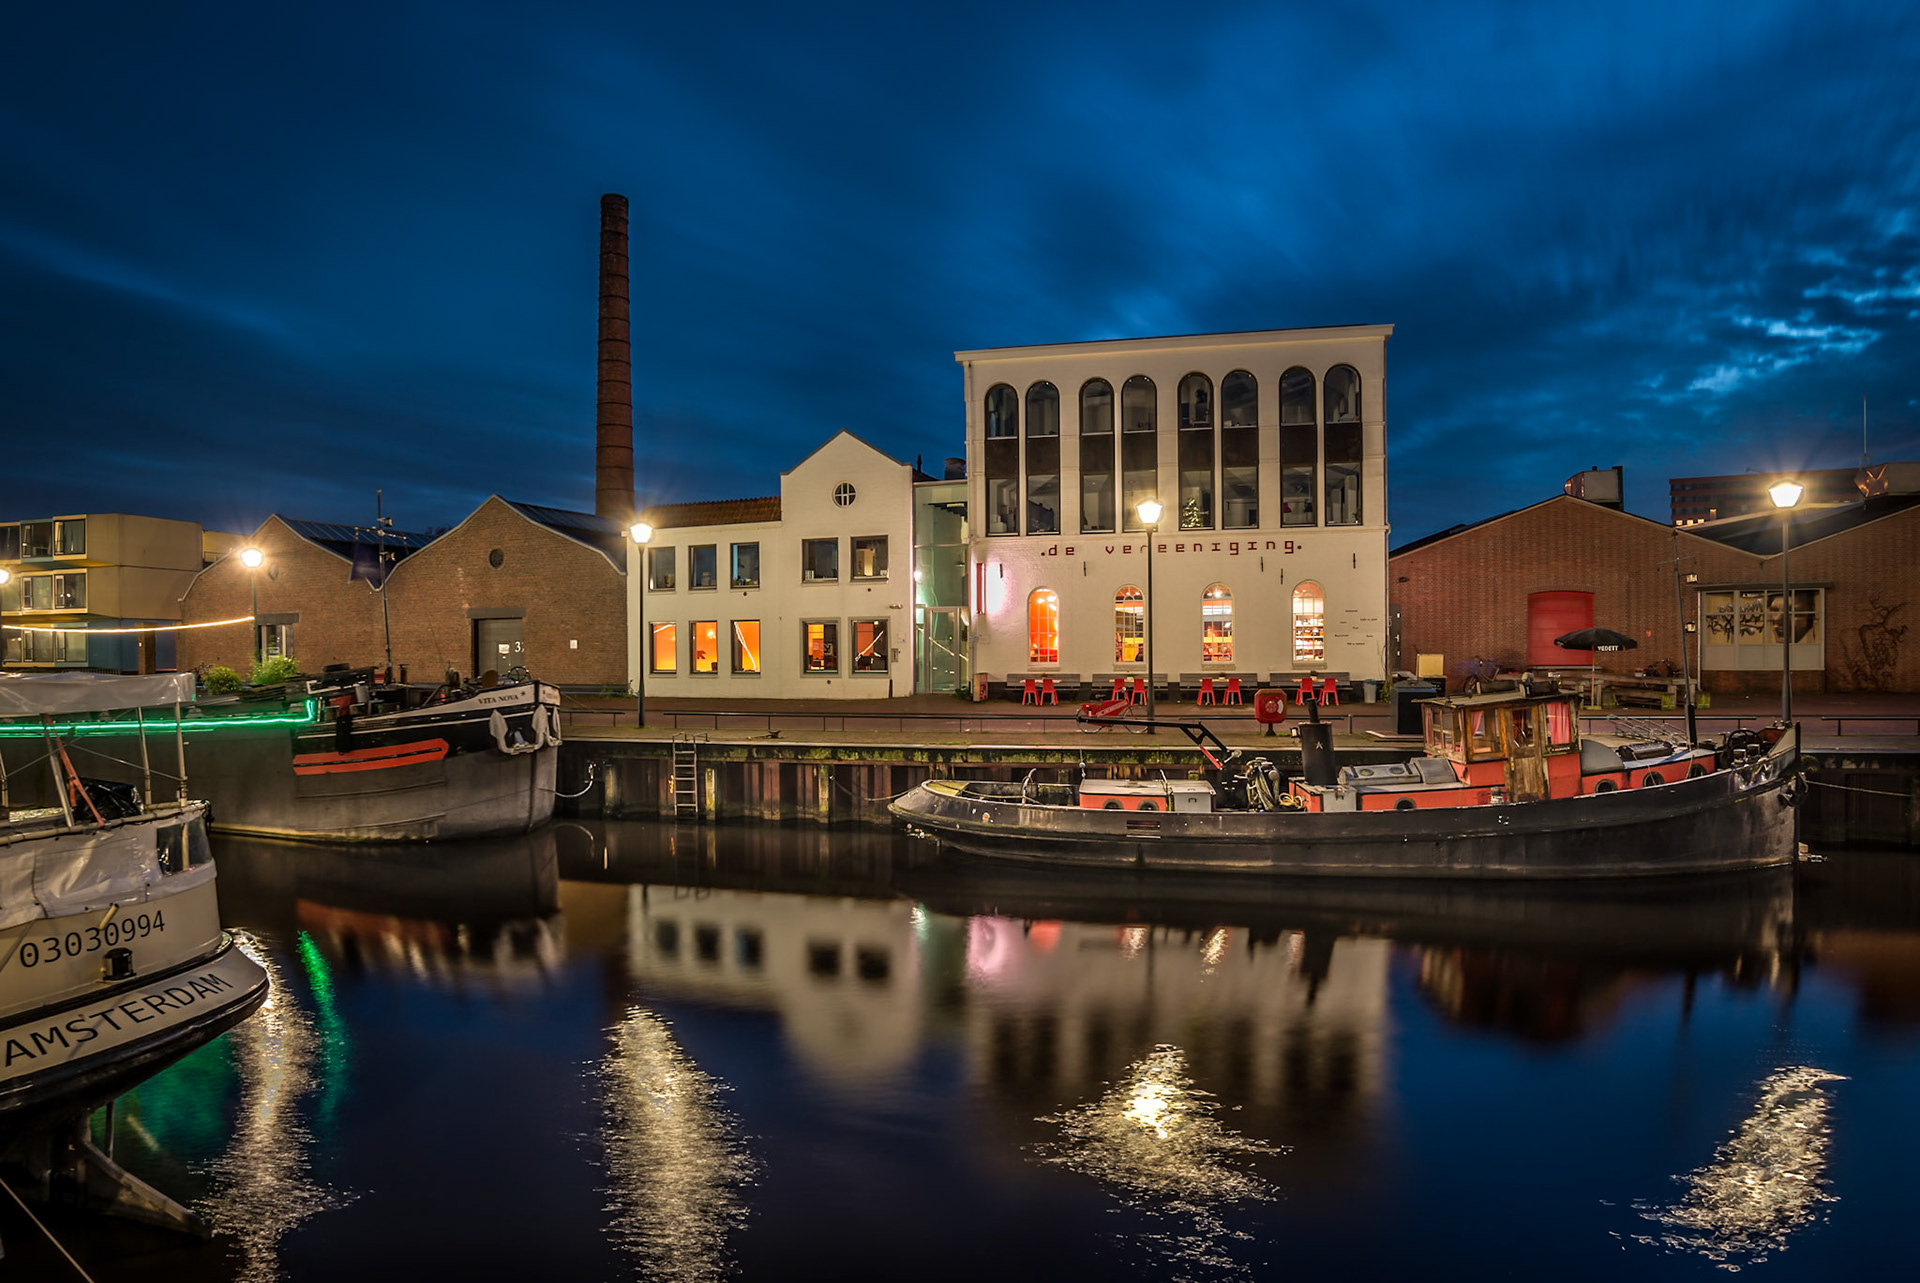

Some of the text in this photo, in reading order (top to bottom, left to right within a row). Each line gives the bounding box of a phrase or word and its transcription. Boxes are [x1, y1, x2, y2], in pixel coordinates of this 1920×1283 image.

[498, 694, 519, 702] NOVA
[19, 910, 166, 968] 03030994
[4, 973, 234, 1067] AMSTERDAM
